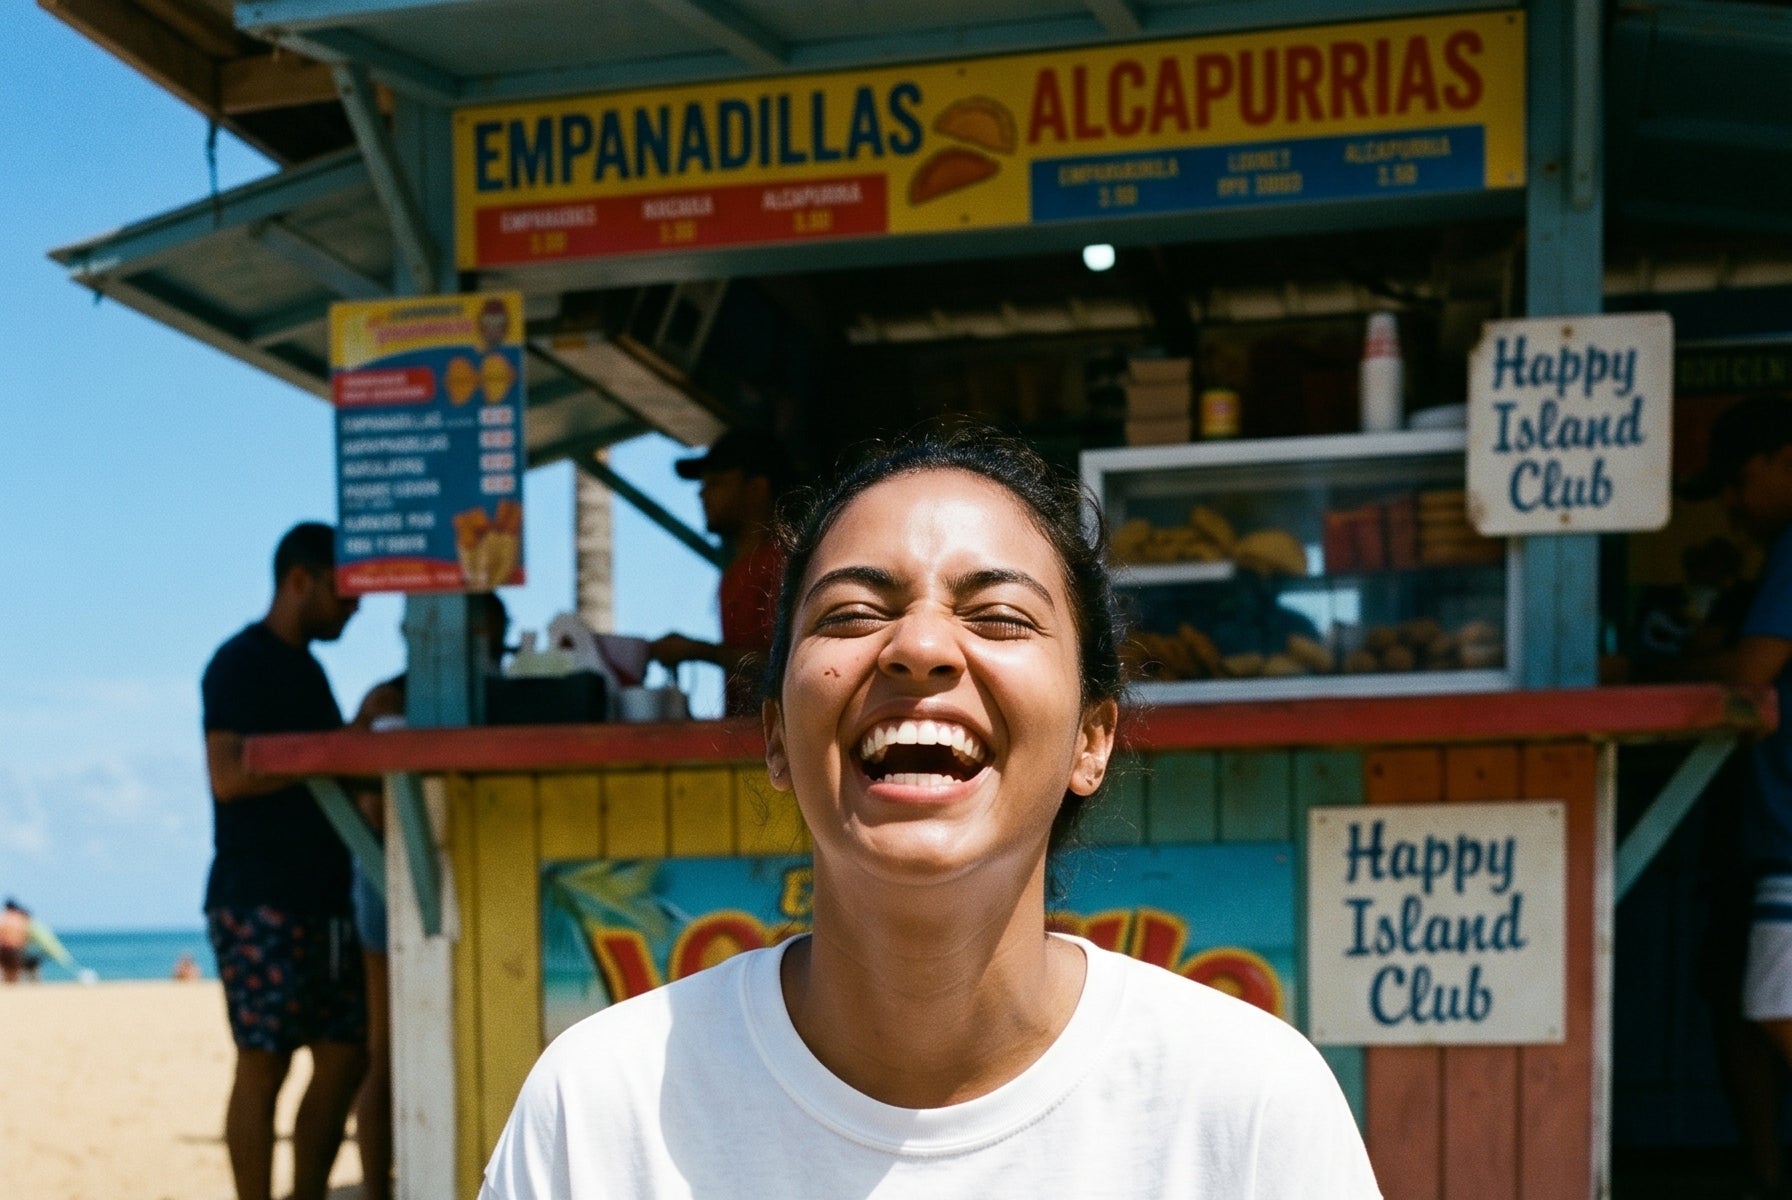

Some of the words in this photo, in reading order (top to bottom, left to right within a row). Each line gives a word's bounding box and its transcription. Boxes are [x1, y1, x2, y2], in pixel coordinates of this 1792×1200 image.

[1027, 30, 1485, 144] ALCAPURRIAS
[474, 82, 924, 192] EMPANADILLAS
[1492, 335, 1637, 399] Happy
[1492, 395, 1645, 454] Island
[1508, 456, 1613, 512] Club
[1345, 819, 1516, 895] Happy
[1344, 892, 1528, 957] Island
[1369, 964, 1493, 1026] Club
